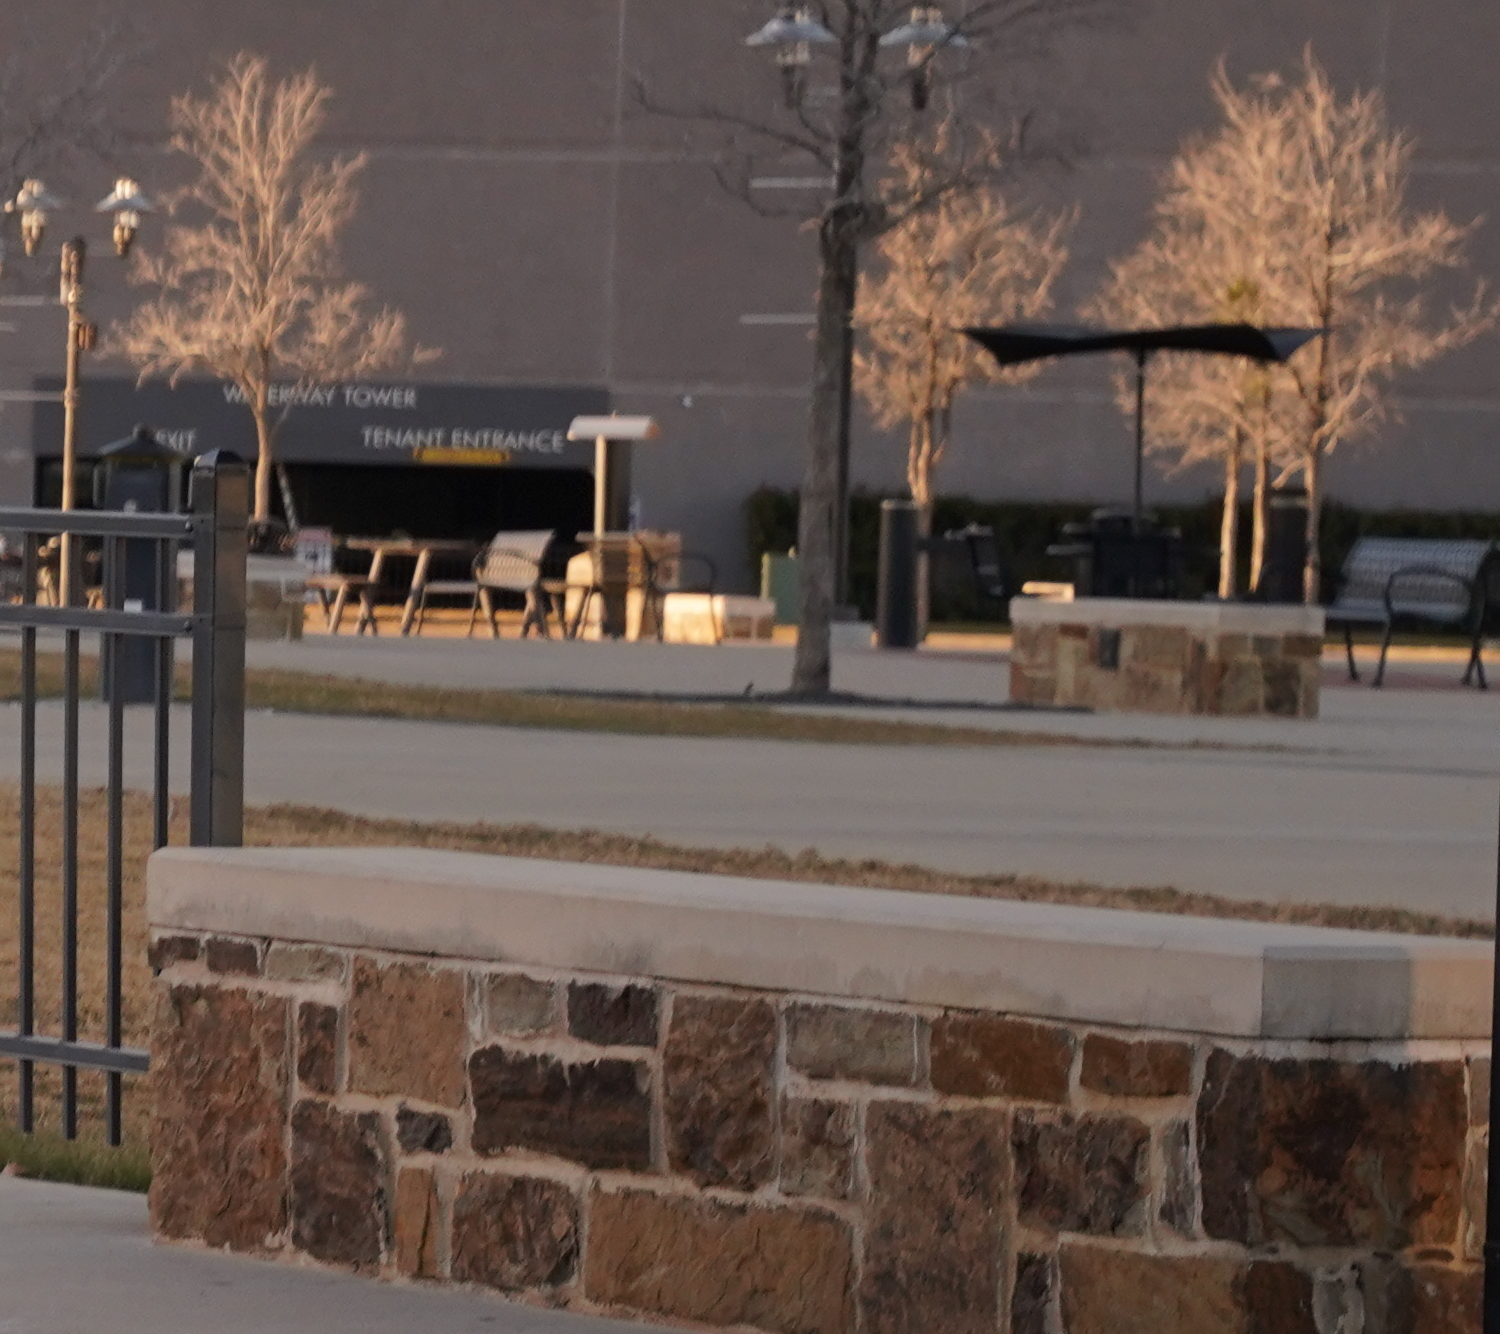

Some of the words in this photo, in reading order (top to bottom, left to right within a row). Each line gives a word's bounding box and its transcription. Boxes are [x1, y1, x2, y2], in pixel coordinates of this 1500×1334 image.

[344, 385, 418, 409] TOWER
[361, 425, 445, 450] TENANT
[451, 426, 566, 454] ENTRANCE
